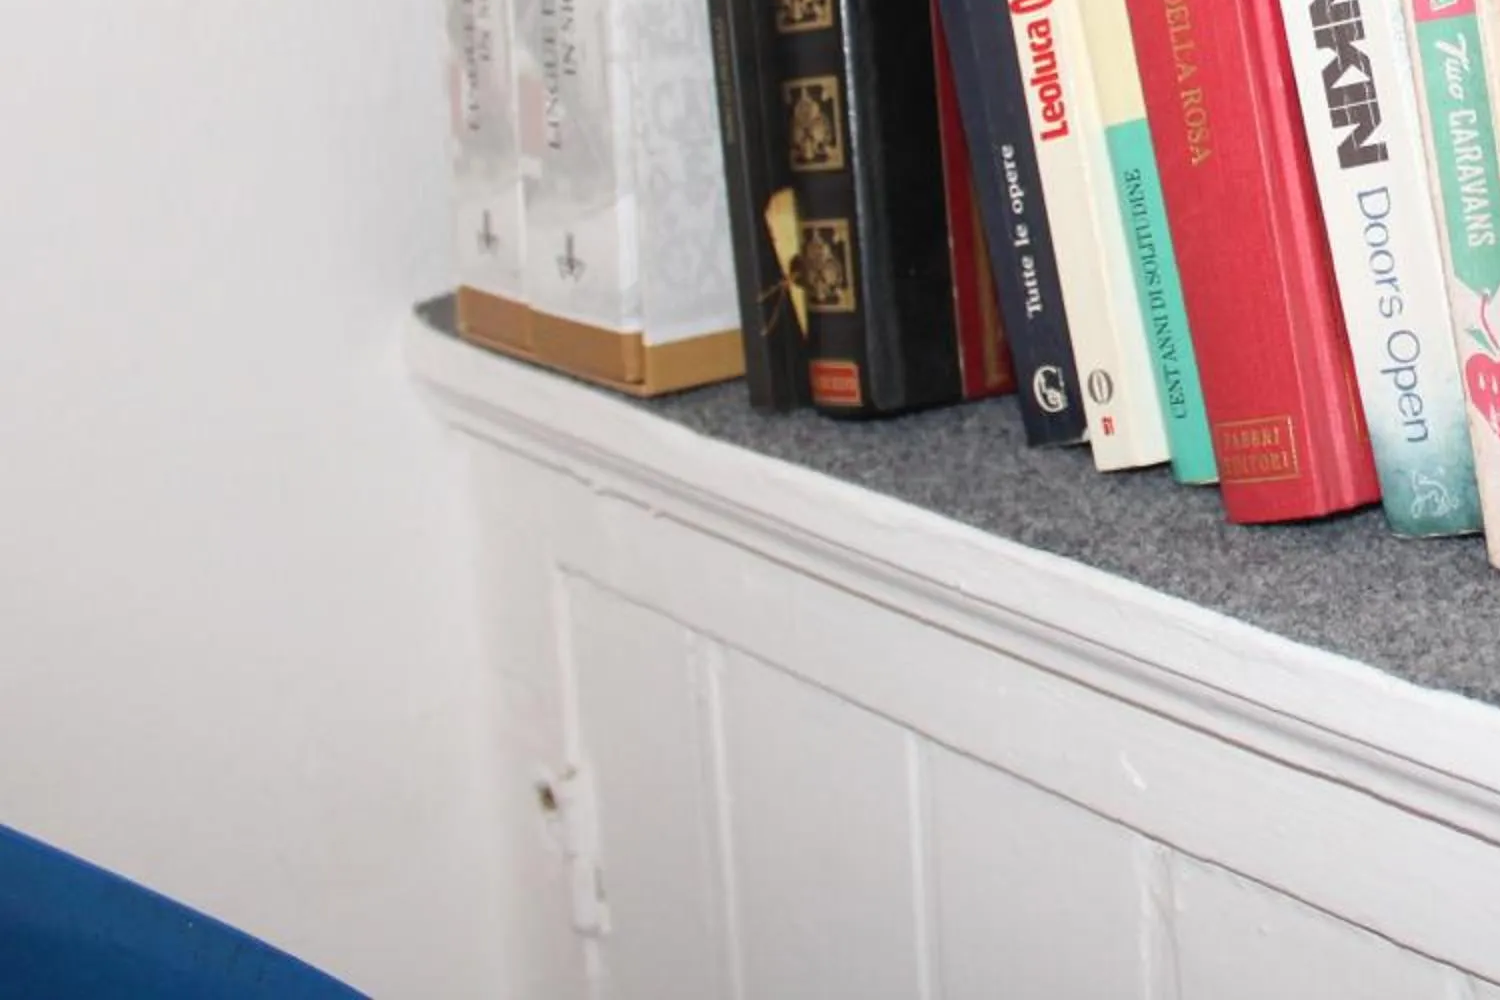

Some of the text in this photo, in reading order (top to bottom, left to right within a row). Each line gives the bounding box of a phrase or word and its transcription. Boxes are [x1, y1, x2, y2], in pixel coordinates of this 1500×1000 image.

[1027, 18, 1069, 141] Leoluca
[1181, 87, 1212, 168] ROSA
[1435, 32, 1497, 249] Two CARAVANS
[1001, 144, 1044, 320] Tutte le opere
[1124, 168, 1162, 287] SOLITUDINE
[1148, 289, 1167, 311] DI
[1356, 186, 1430, 445] Doors Open
